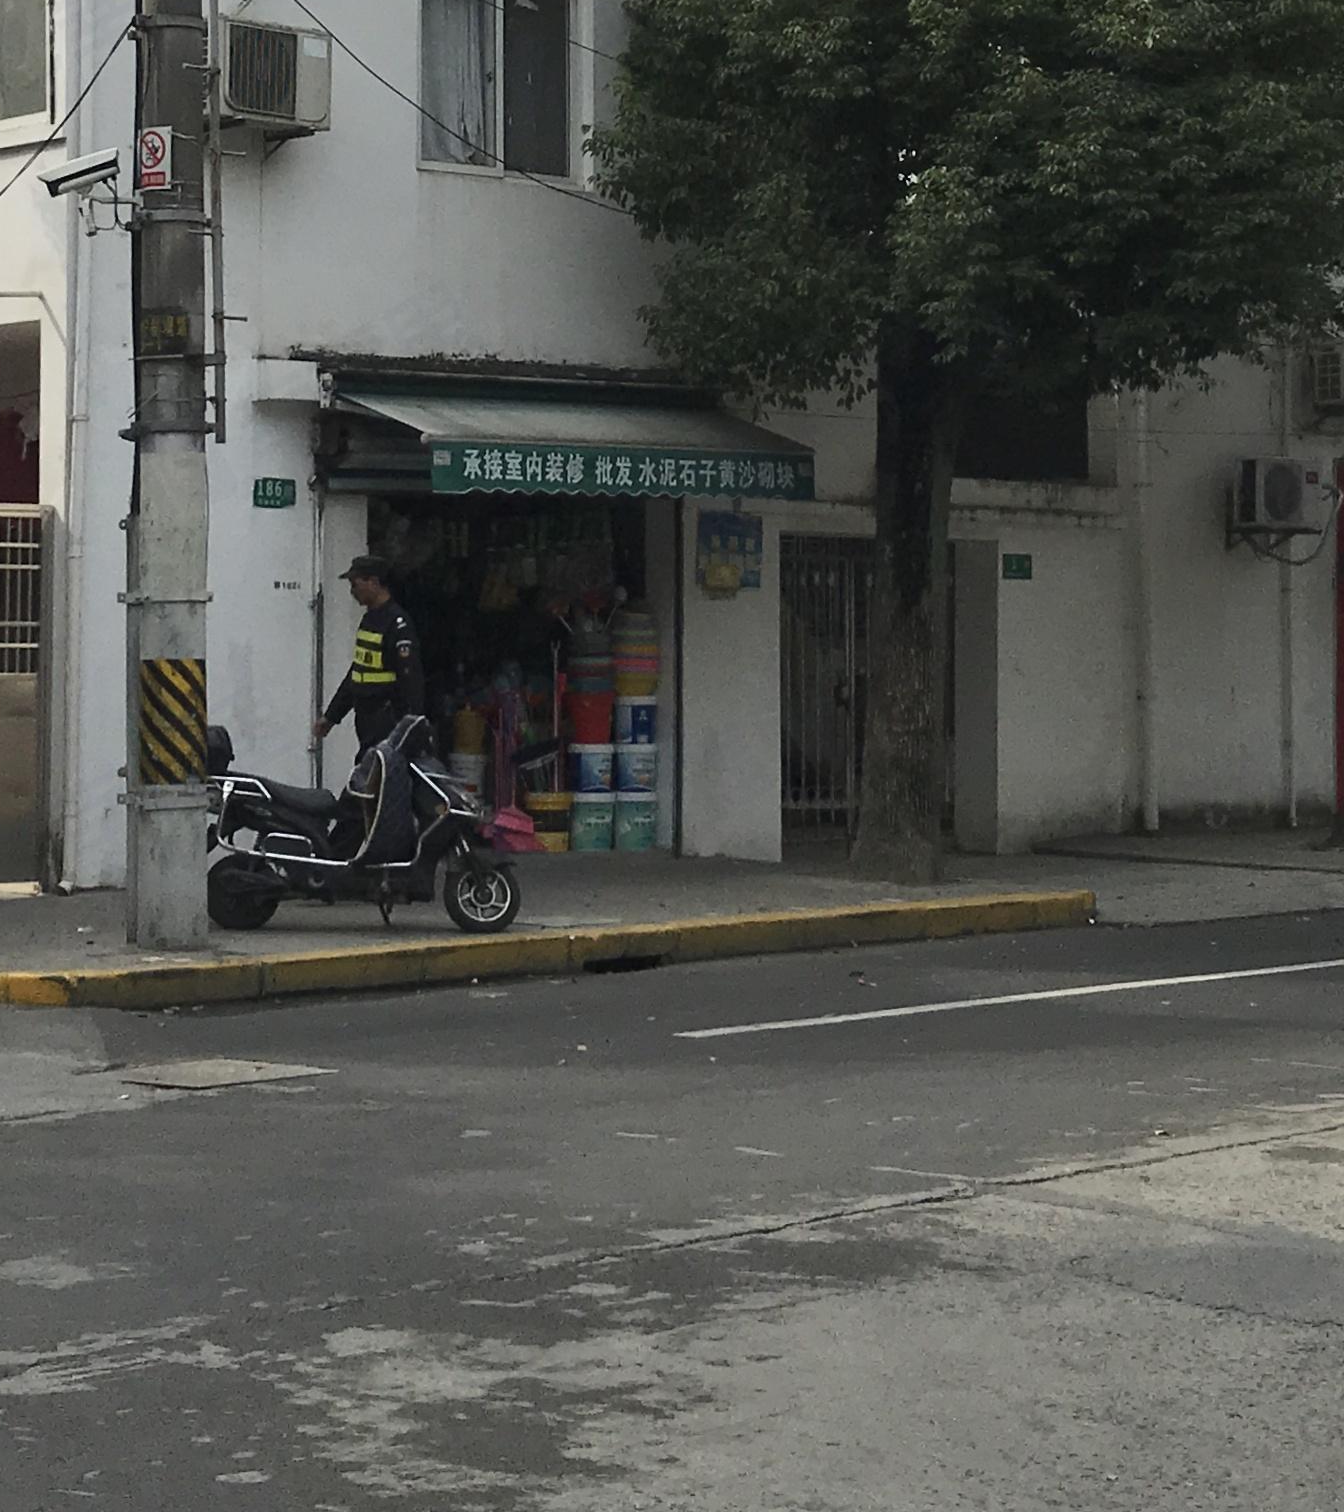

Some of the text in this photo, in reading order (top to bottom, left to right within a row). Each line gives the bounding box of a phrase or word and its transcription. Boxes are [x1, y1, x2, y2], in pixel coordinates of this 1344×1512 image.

[463, 450, 585, 482] 承接室内装修
[595, 455, 633, 486] 批发
[258, 480, 282, 496] 186
